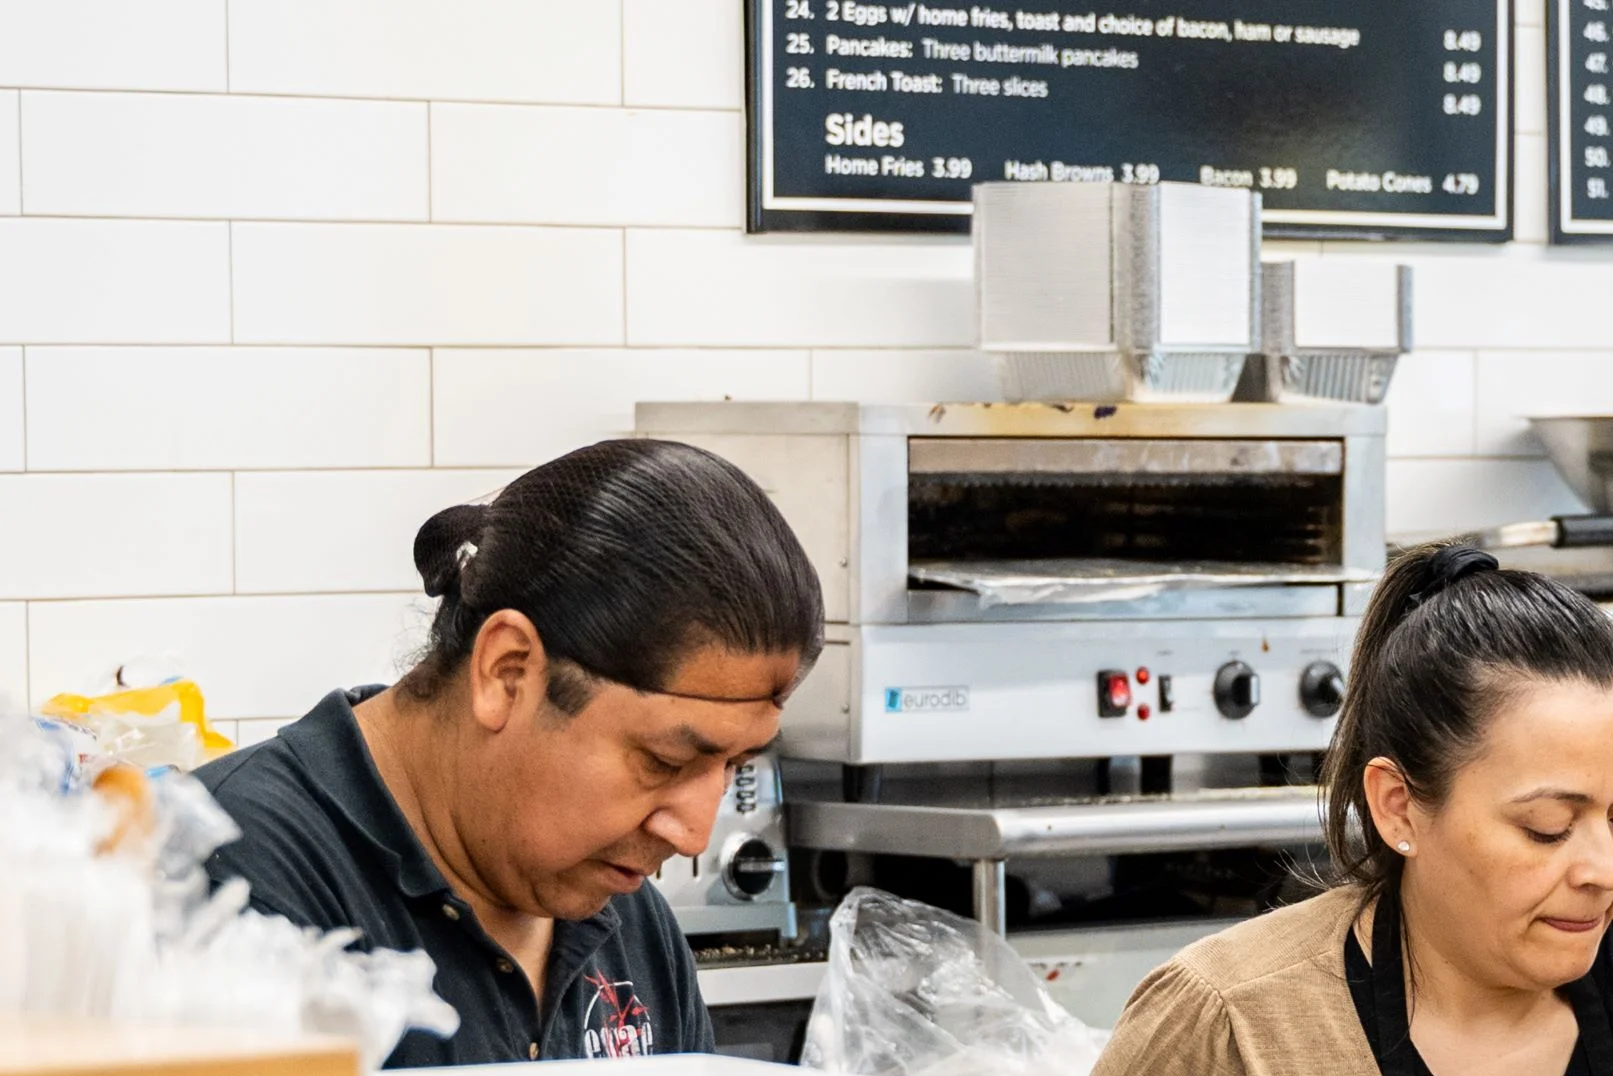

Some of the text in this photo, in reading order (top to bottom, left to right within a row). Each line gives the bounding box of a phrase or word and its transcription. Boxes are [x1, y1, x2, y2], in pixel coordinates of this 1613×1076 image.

[786, 0, 815, 19] 24.
[826, 0, 839, 20] 2
[842, 1, 887, 26] Eggs
[890, 3, 915, 26] w/
[917, 4, 968, 26] home
[970, 6, 1013, 31] fries,
[1015, 11, 1060, 31] toast
[1062, 13, 1096, 33] and
[1098, 14, 1153, 36] choice
[1155, 16, 1175, 36] of
[1177, 18, 1232, 41] bacon,
[1234, 20, 1271, 41] ham
[1273, 25, 1293, 42] or
[1294, 27, 1360, 49] sausage
[786, 33, 815, 54] 25.
[826, 34, 913, 58] Pancakes:
[921, 38, 971, 61] Three
[973, 41, 1059, 64] buttermilk
[1061, 48, 1139, 68] pancakes
[786, 67, 815, 88] 26.
[826, 69, 887, 91] French
[889, 71, 943, 93] Toast:
[952, 73, 1000, 95] Three
[1002, 76, 1049, 97] slices
[825, 113, 905, 148] Sides
[825, 154, 878, 175] Home
[881, 155, 924, 177] Fries
[931, 157, 973, 179] 3.99
[1004, 160, 1048, 181] Hash
[1051, 161, 1114, 182] Browns
[1122, 163, 1160, 184] 3.99
[1200, 165, 1253, 187] Bacon
[1259, 167, 1298, 189] 3.99
[1326, 168, 1380, 191] Potato
[903, 688, 966, 708] eurodib
